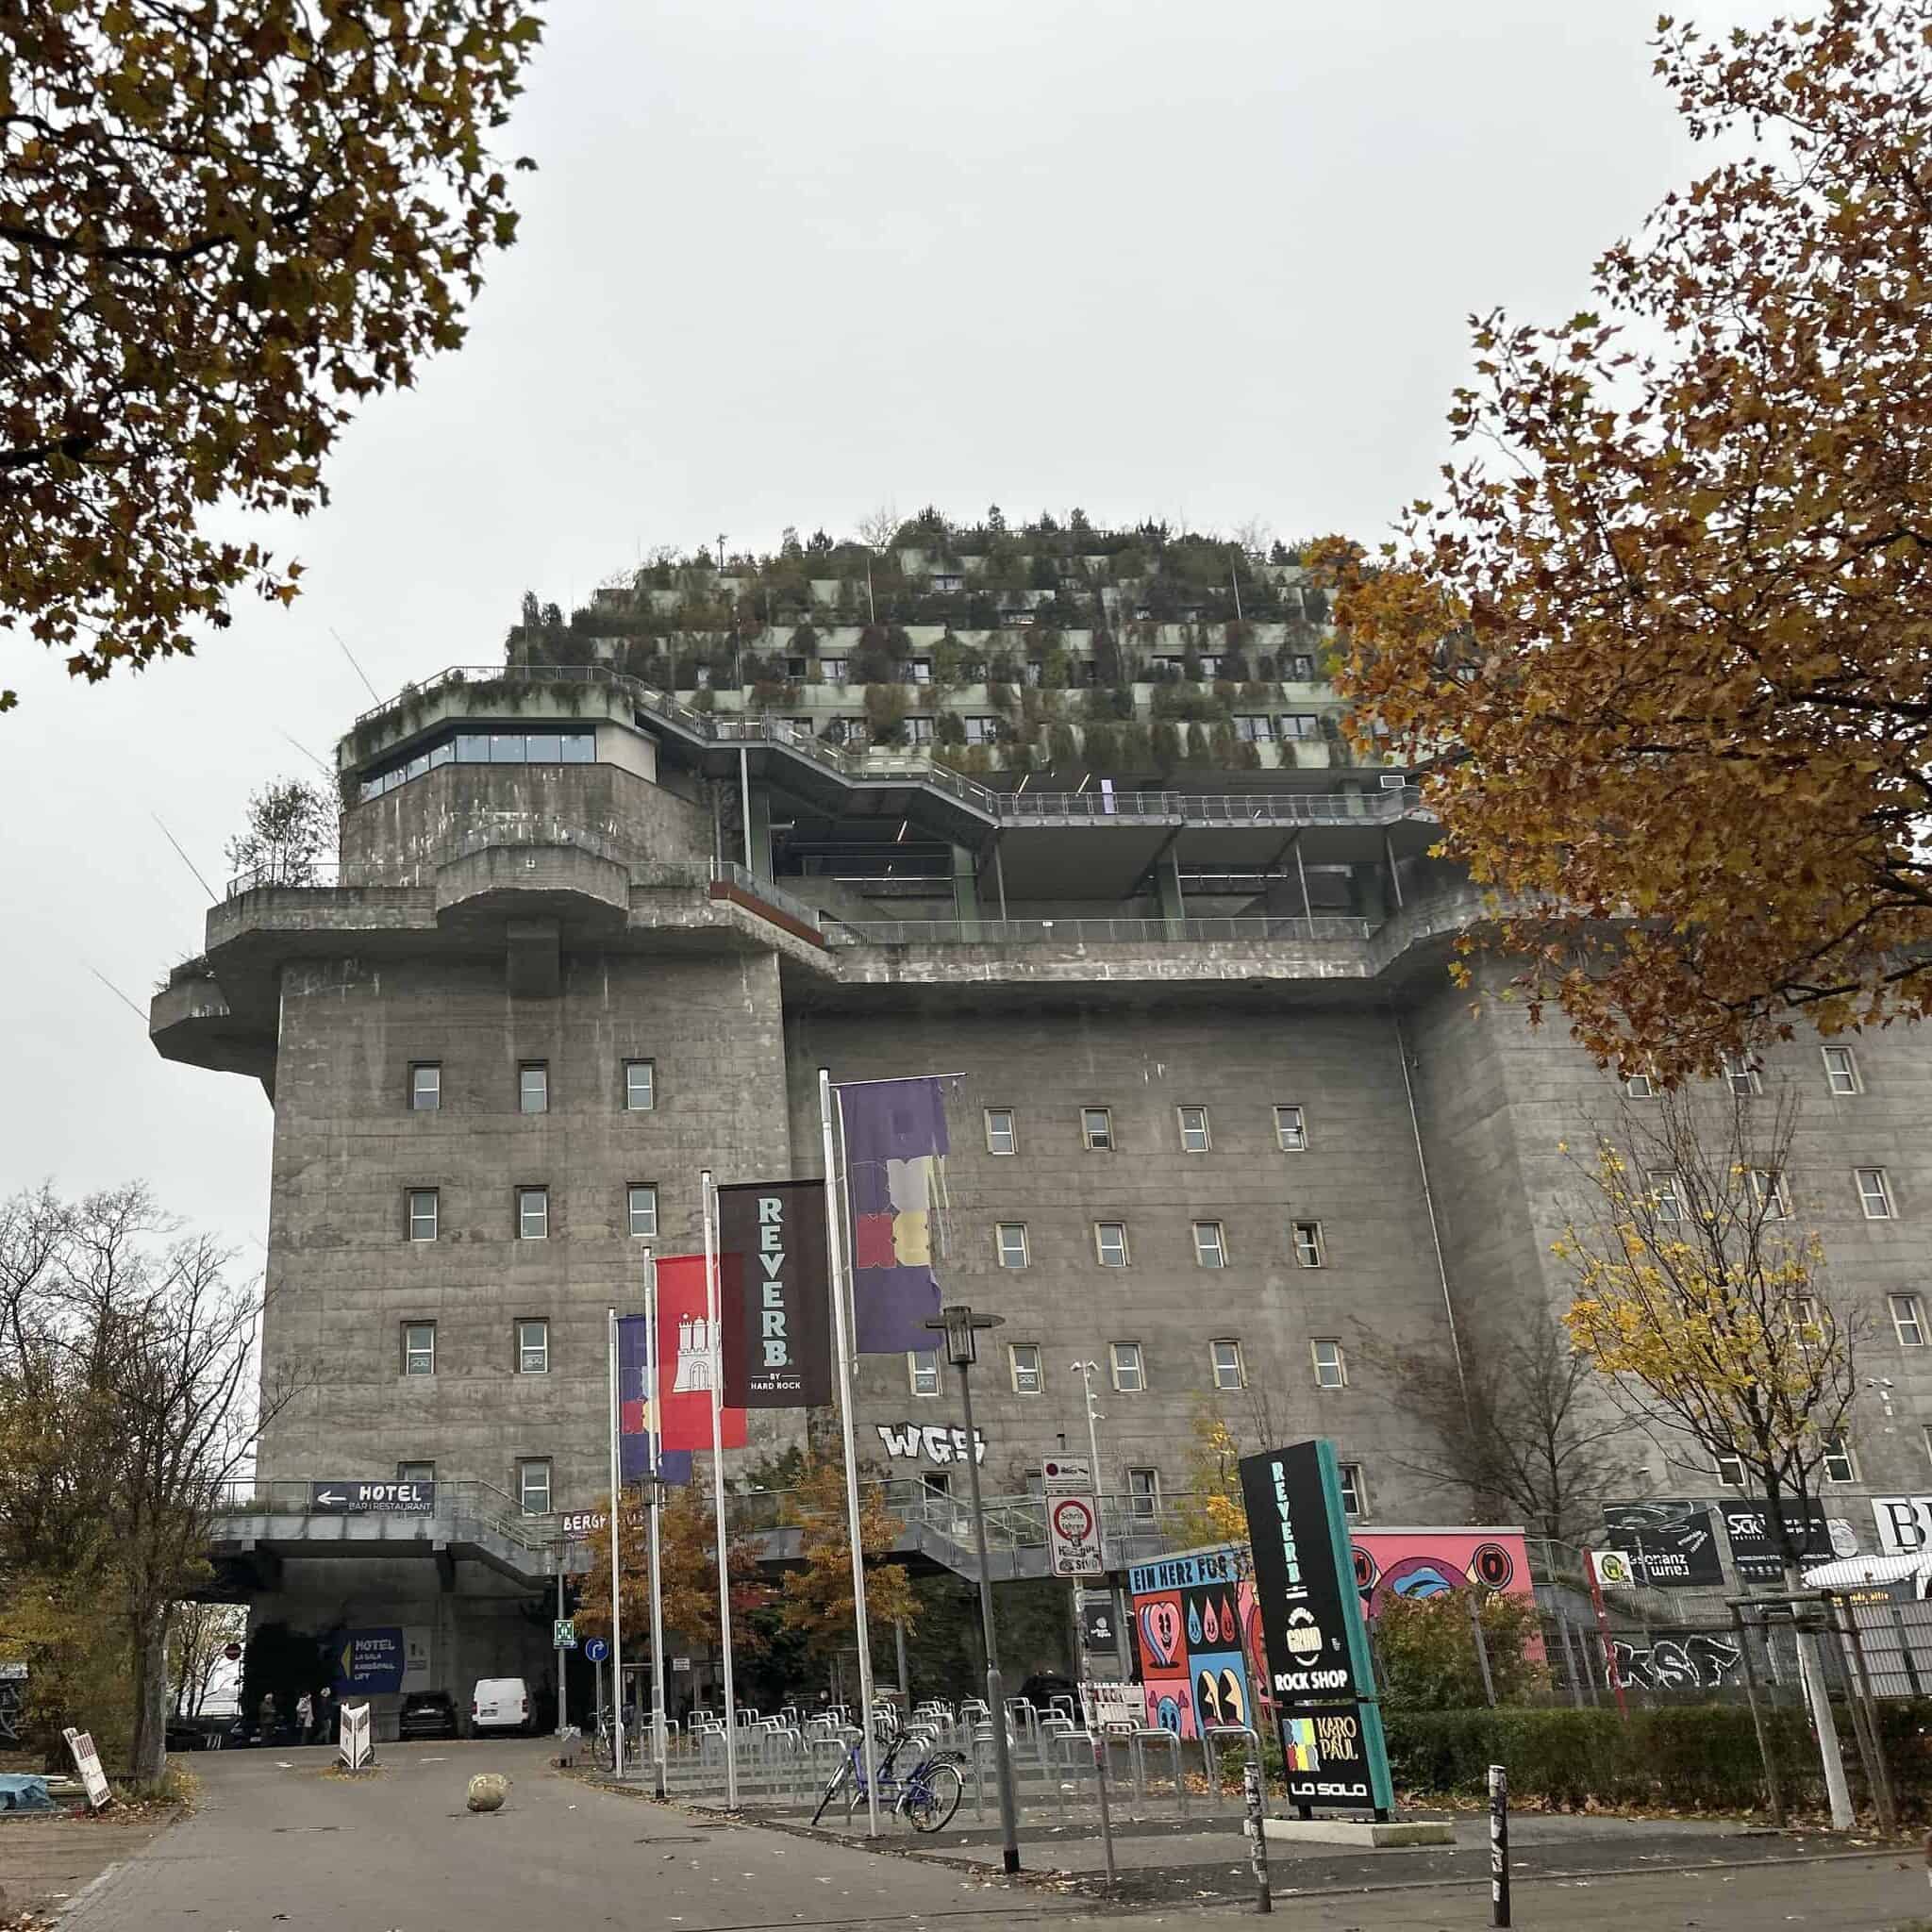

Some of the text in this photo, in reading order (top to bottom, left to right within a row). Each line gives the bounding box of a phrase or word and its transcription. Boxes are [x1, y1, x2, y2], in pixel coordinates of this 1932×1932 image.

[758, 1197, 790, 1367] REVERB
[359, 1485, 422, 1502] HOTEL
[348, 1502, 431, 1510] BAR RESTAURANT
[1271, 1461, 1301, 1583] REVERB
[1133, 1566, 1156, 1591] EIN
[1158, 1560, 1193, 1587] HERZ
[355, 1640, 395, 1652] HOTEL
[1274, 1670, 1348, 1691] ROCK SHOP
[1317, 1716, 1357, 1738] KARO
[1320, 1736, 1358, 1760] PAUL
